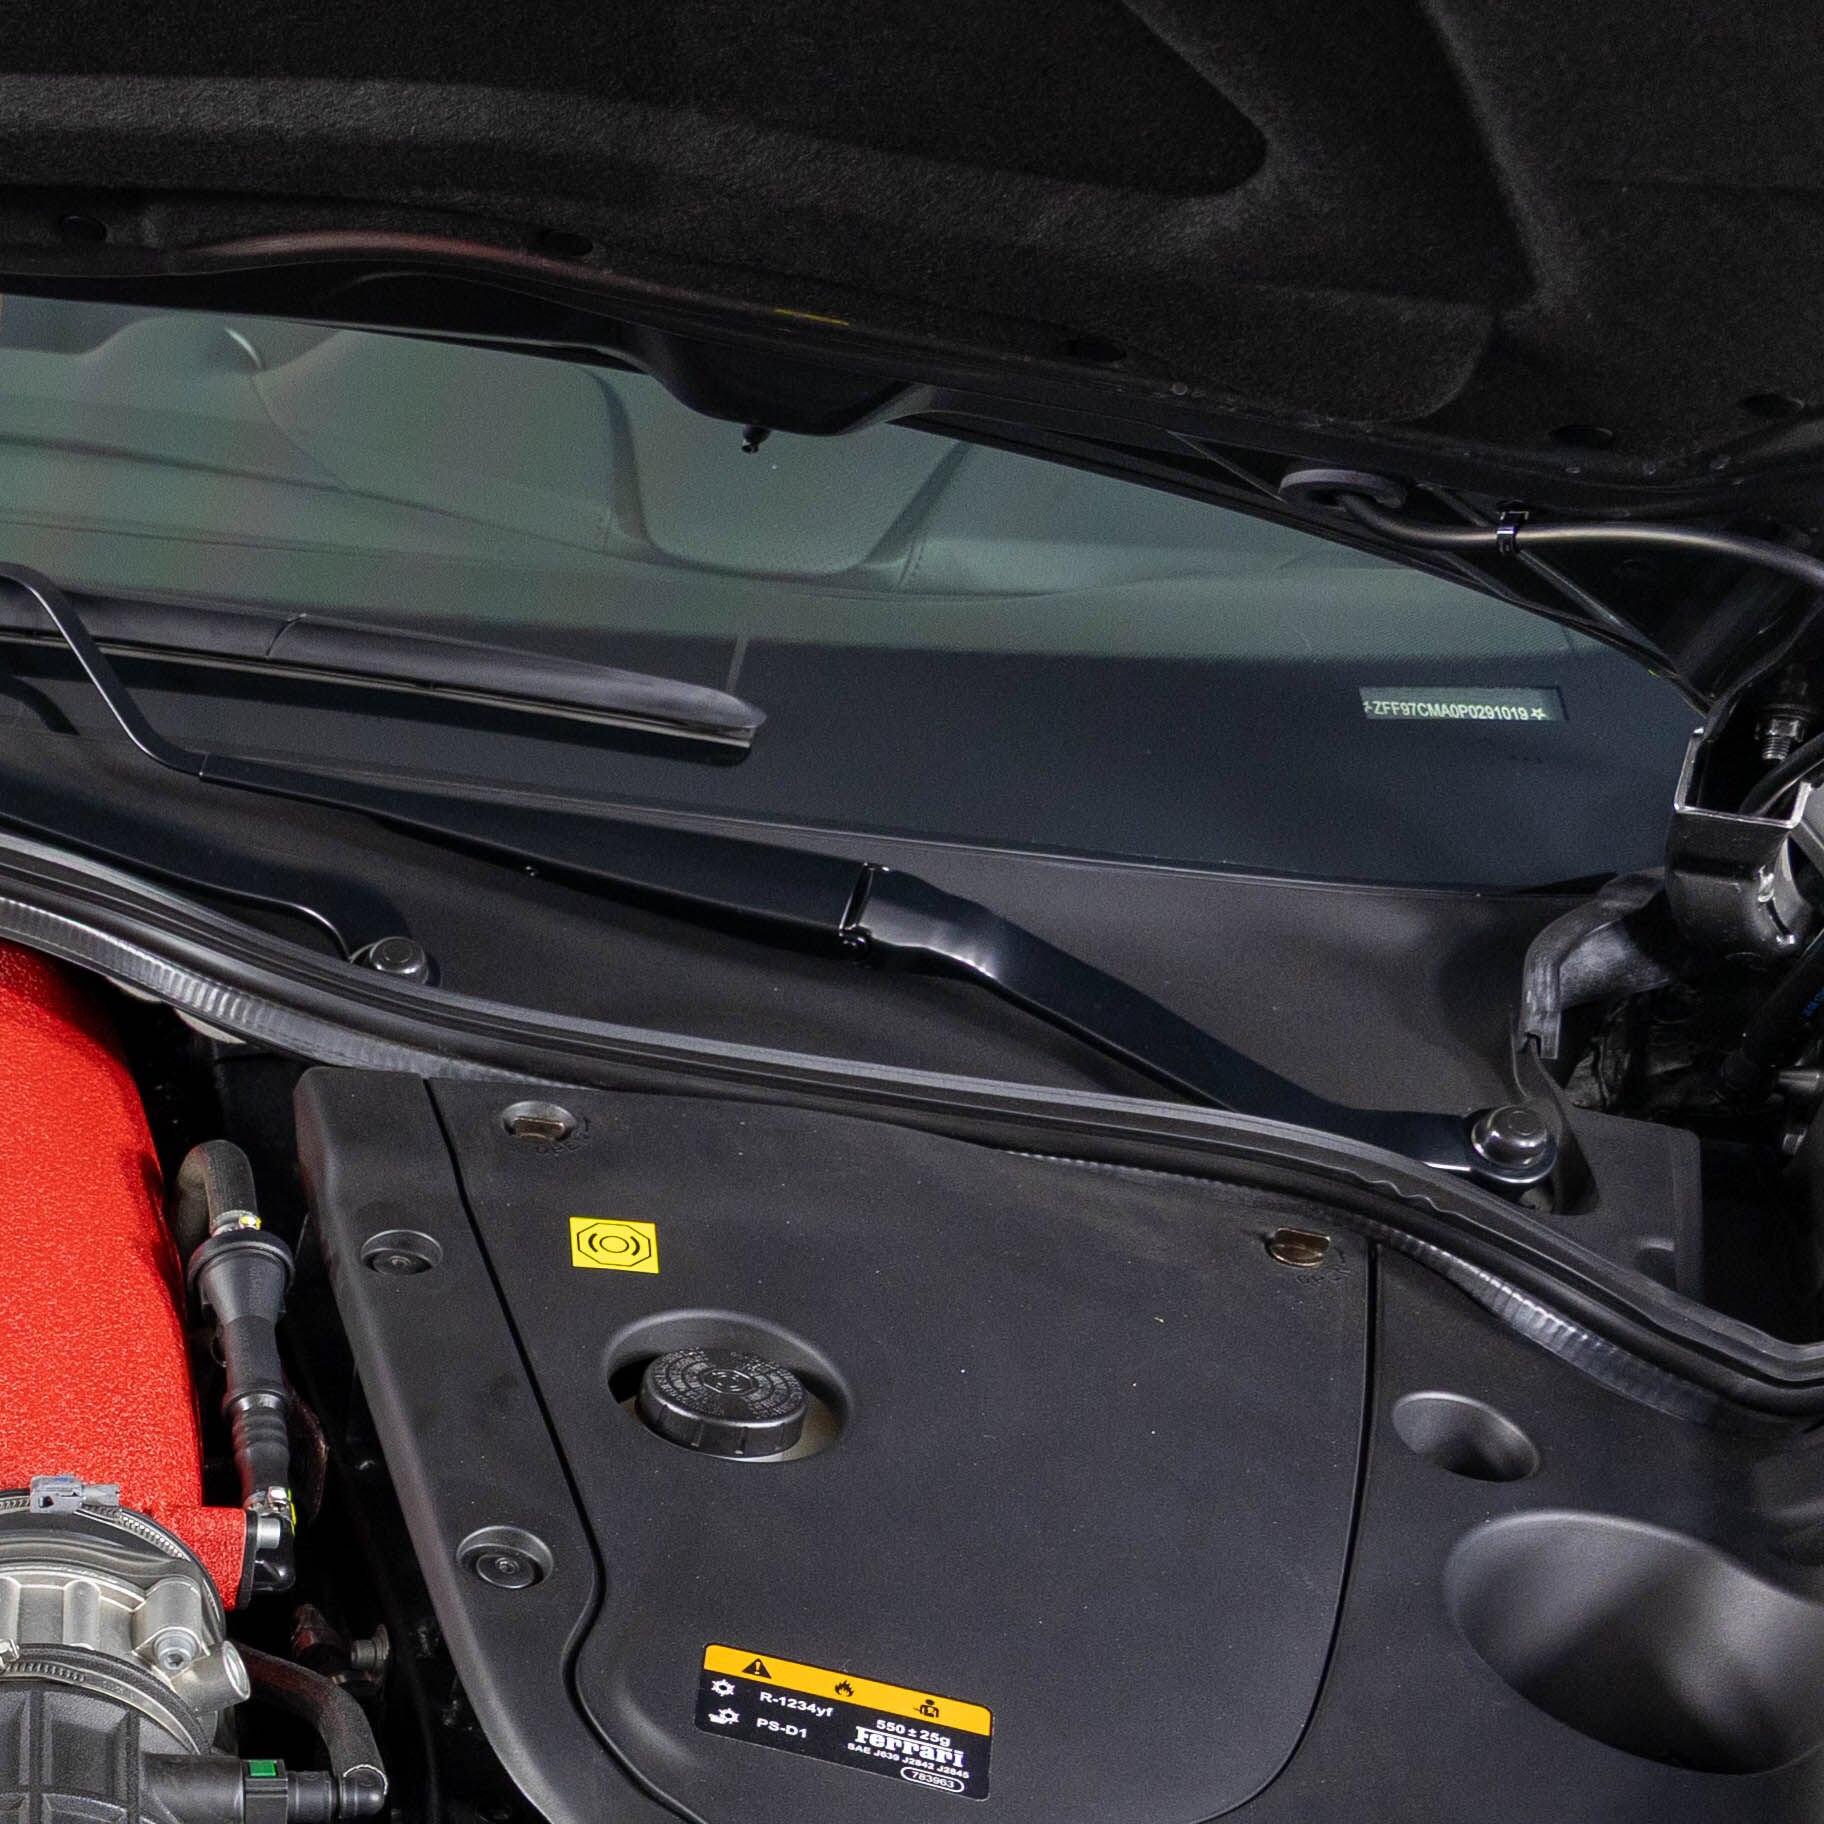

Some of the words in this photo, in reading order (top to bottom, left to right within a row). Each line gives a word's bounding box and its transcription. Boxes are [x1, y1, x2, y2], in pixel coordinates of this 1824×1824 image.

[759, 1691, 834, 1718] R-1234yf
[756, 1717, 808, 1739] PS-D1
[876, 1719, 906, 1735] 550
[919, 1729, 951, 1747] 25g
[848, 1743, 871, 1755] SAE
[854, 1726, 965, 1768] Ferrari
[912, 1770, 955, 1788] 783963
